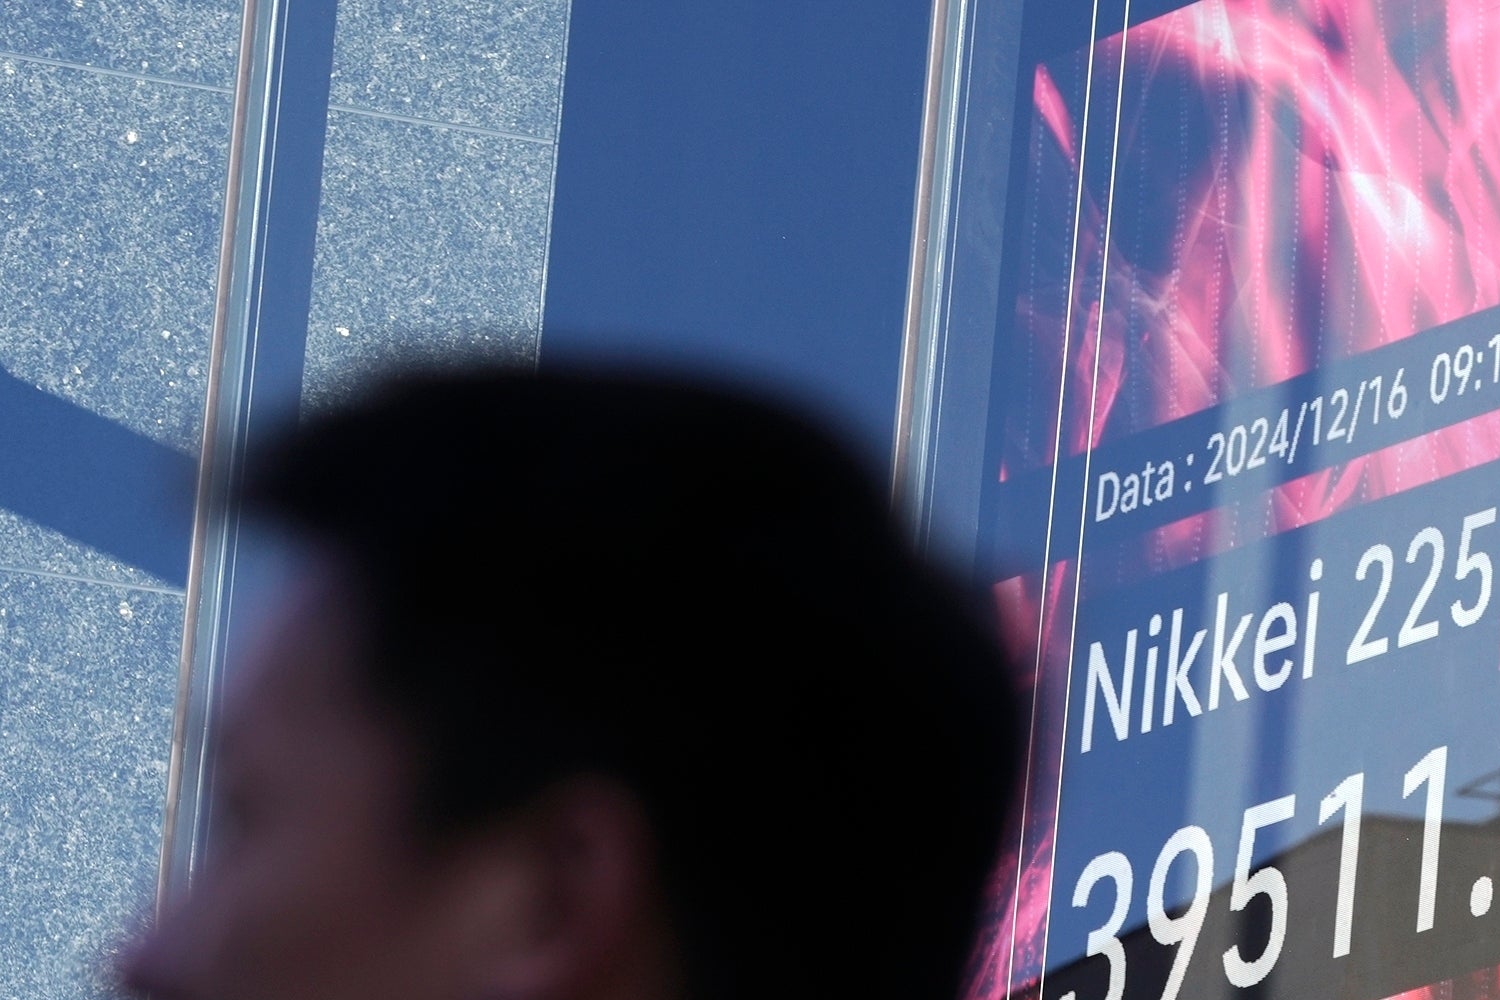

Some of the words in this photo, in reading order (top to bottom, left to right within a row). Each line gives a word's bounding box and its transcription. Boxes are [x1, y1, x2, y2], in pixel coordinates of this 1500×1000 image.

[1095, 464, 1174, 522] Data
[1205, 368, 1408, 486] 2024/12/16
[1081, 559, 1323, 753] Nikkei
[1346, 508, 1497, 663] 225
